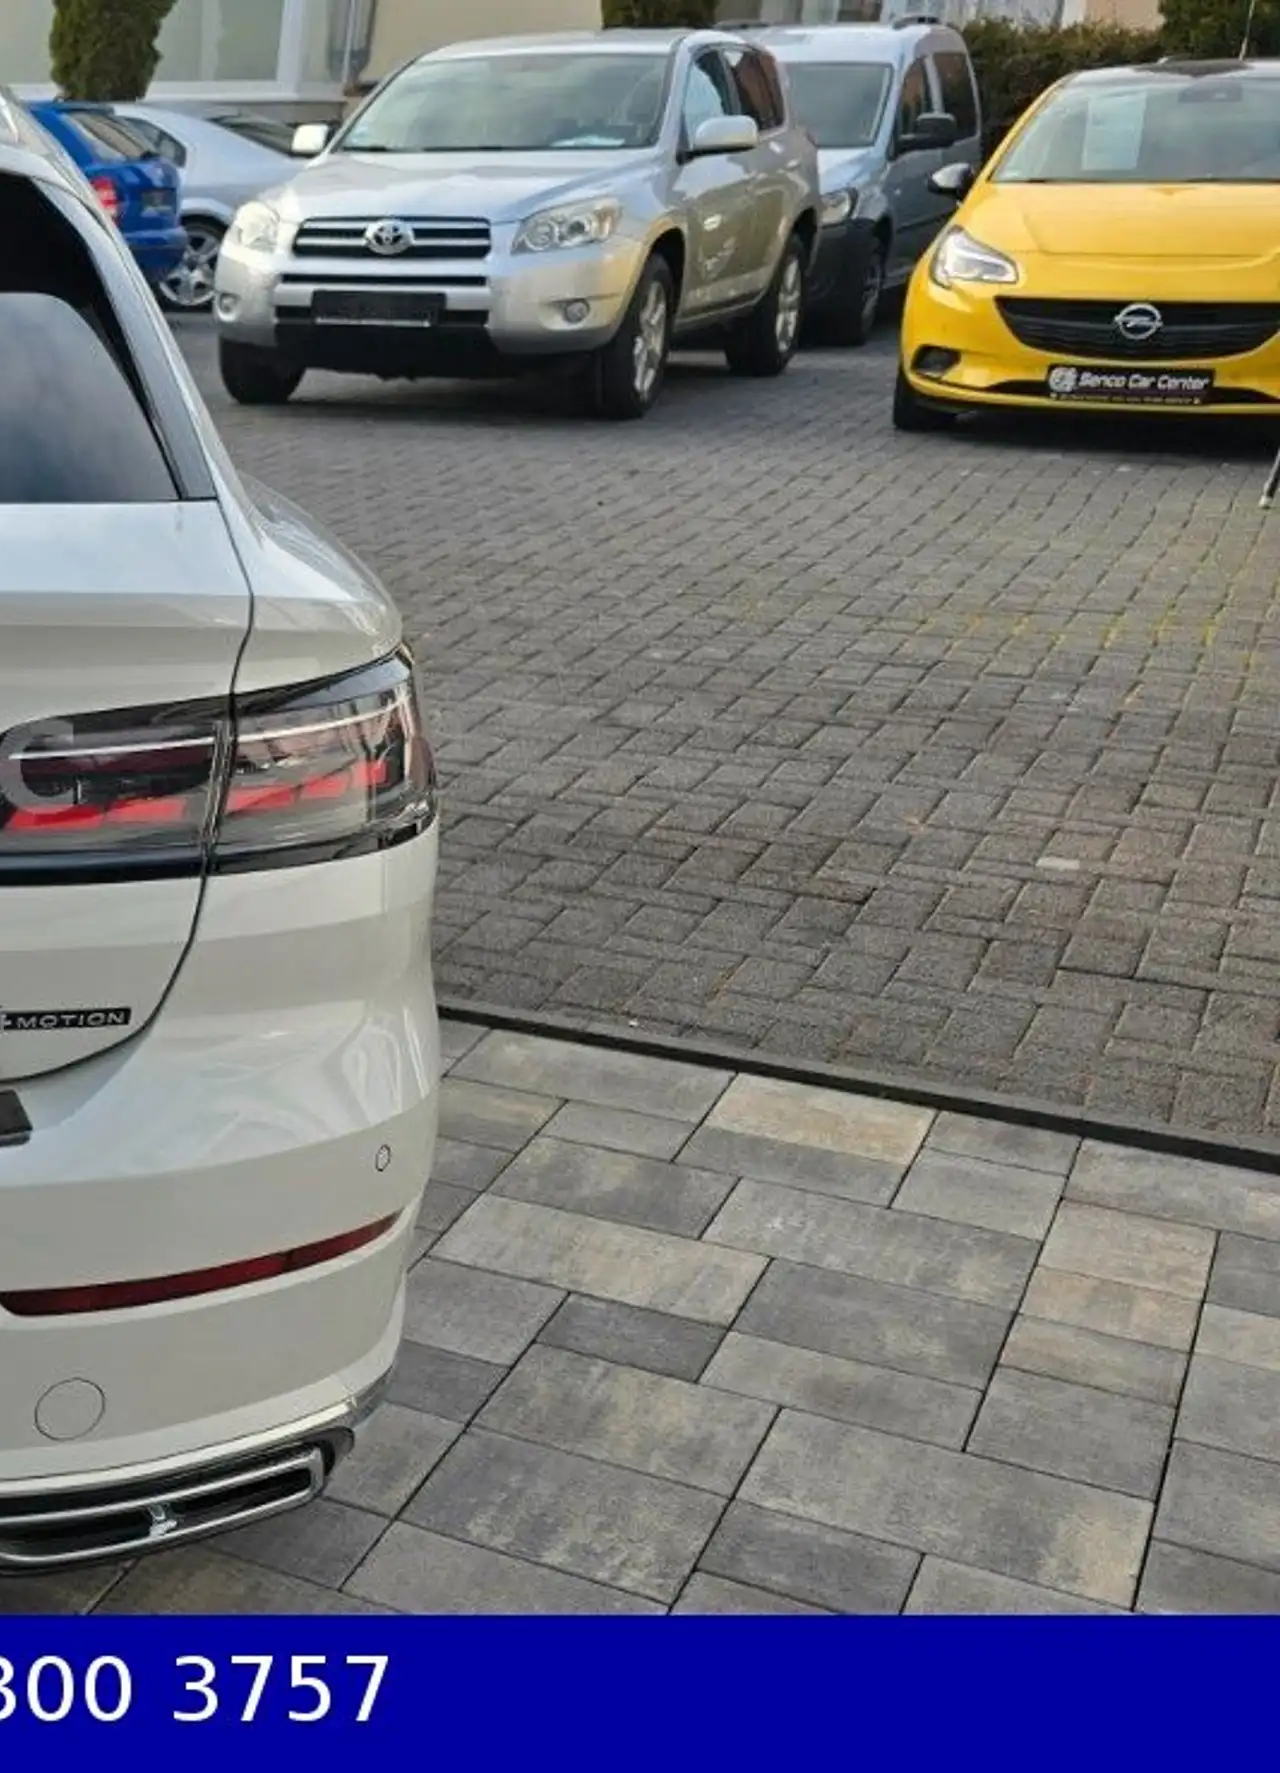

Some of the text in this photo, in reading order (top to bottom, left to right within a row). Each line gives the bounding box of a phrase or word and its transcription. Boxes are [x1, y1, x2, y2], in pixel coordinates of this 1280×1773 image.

[1078, 371, 1127, 389] Senco
[1128, 373, 1156, 390] Car
[1157, 374, 1209, 391] Center
